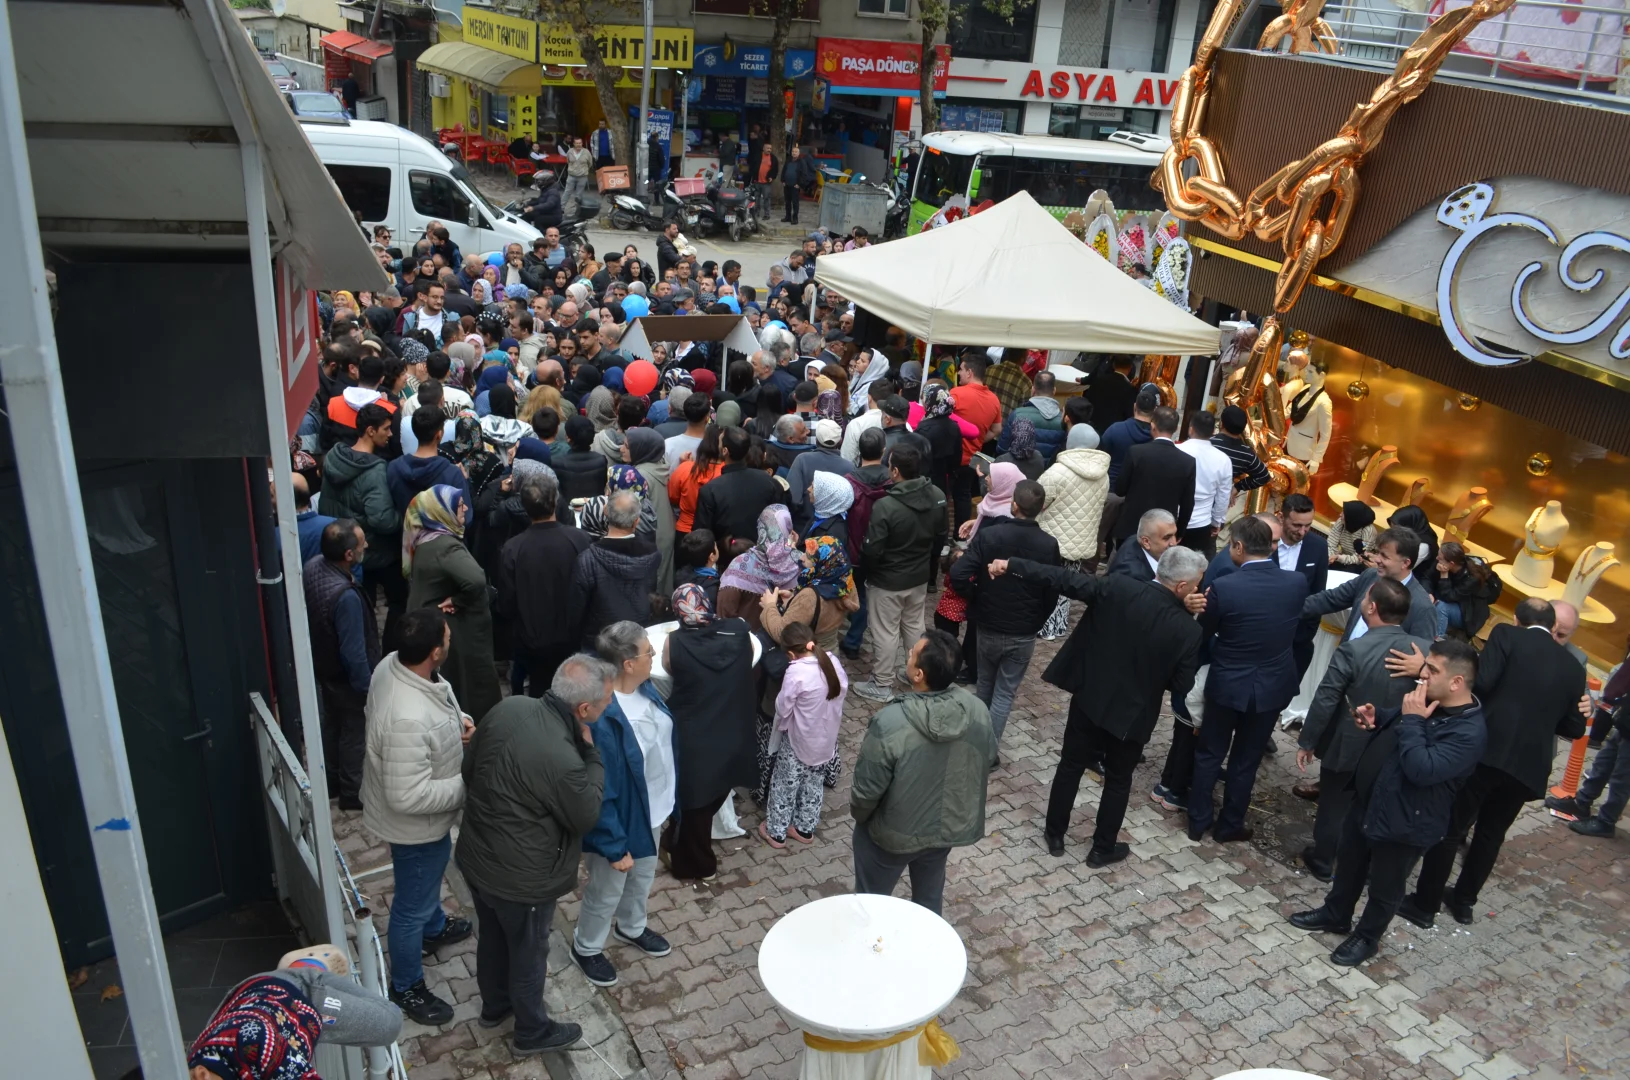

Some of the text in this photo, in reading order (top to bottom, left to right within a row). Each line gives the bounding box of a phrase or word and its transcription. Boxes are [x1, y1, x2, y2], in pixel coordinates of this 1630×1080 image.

[469, 17, 529, 51] MERSİN TANTUNİ
[544, 47, 574, 58] Mersin
[581, 34, 688, 61] ANTUNİ
[743, 53, 765, 62] SEZER
[740, 61, 769, 71] TİCARET
[841, 56, 875, 75] PAŞA
[1020, 69, 1118, 103] ASYA
[1116, 237, 1136, 262] HAYIRLI
